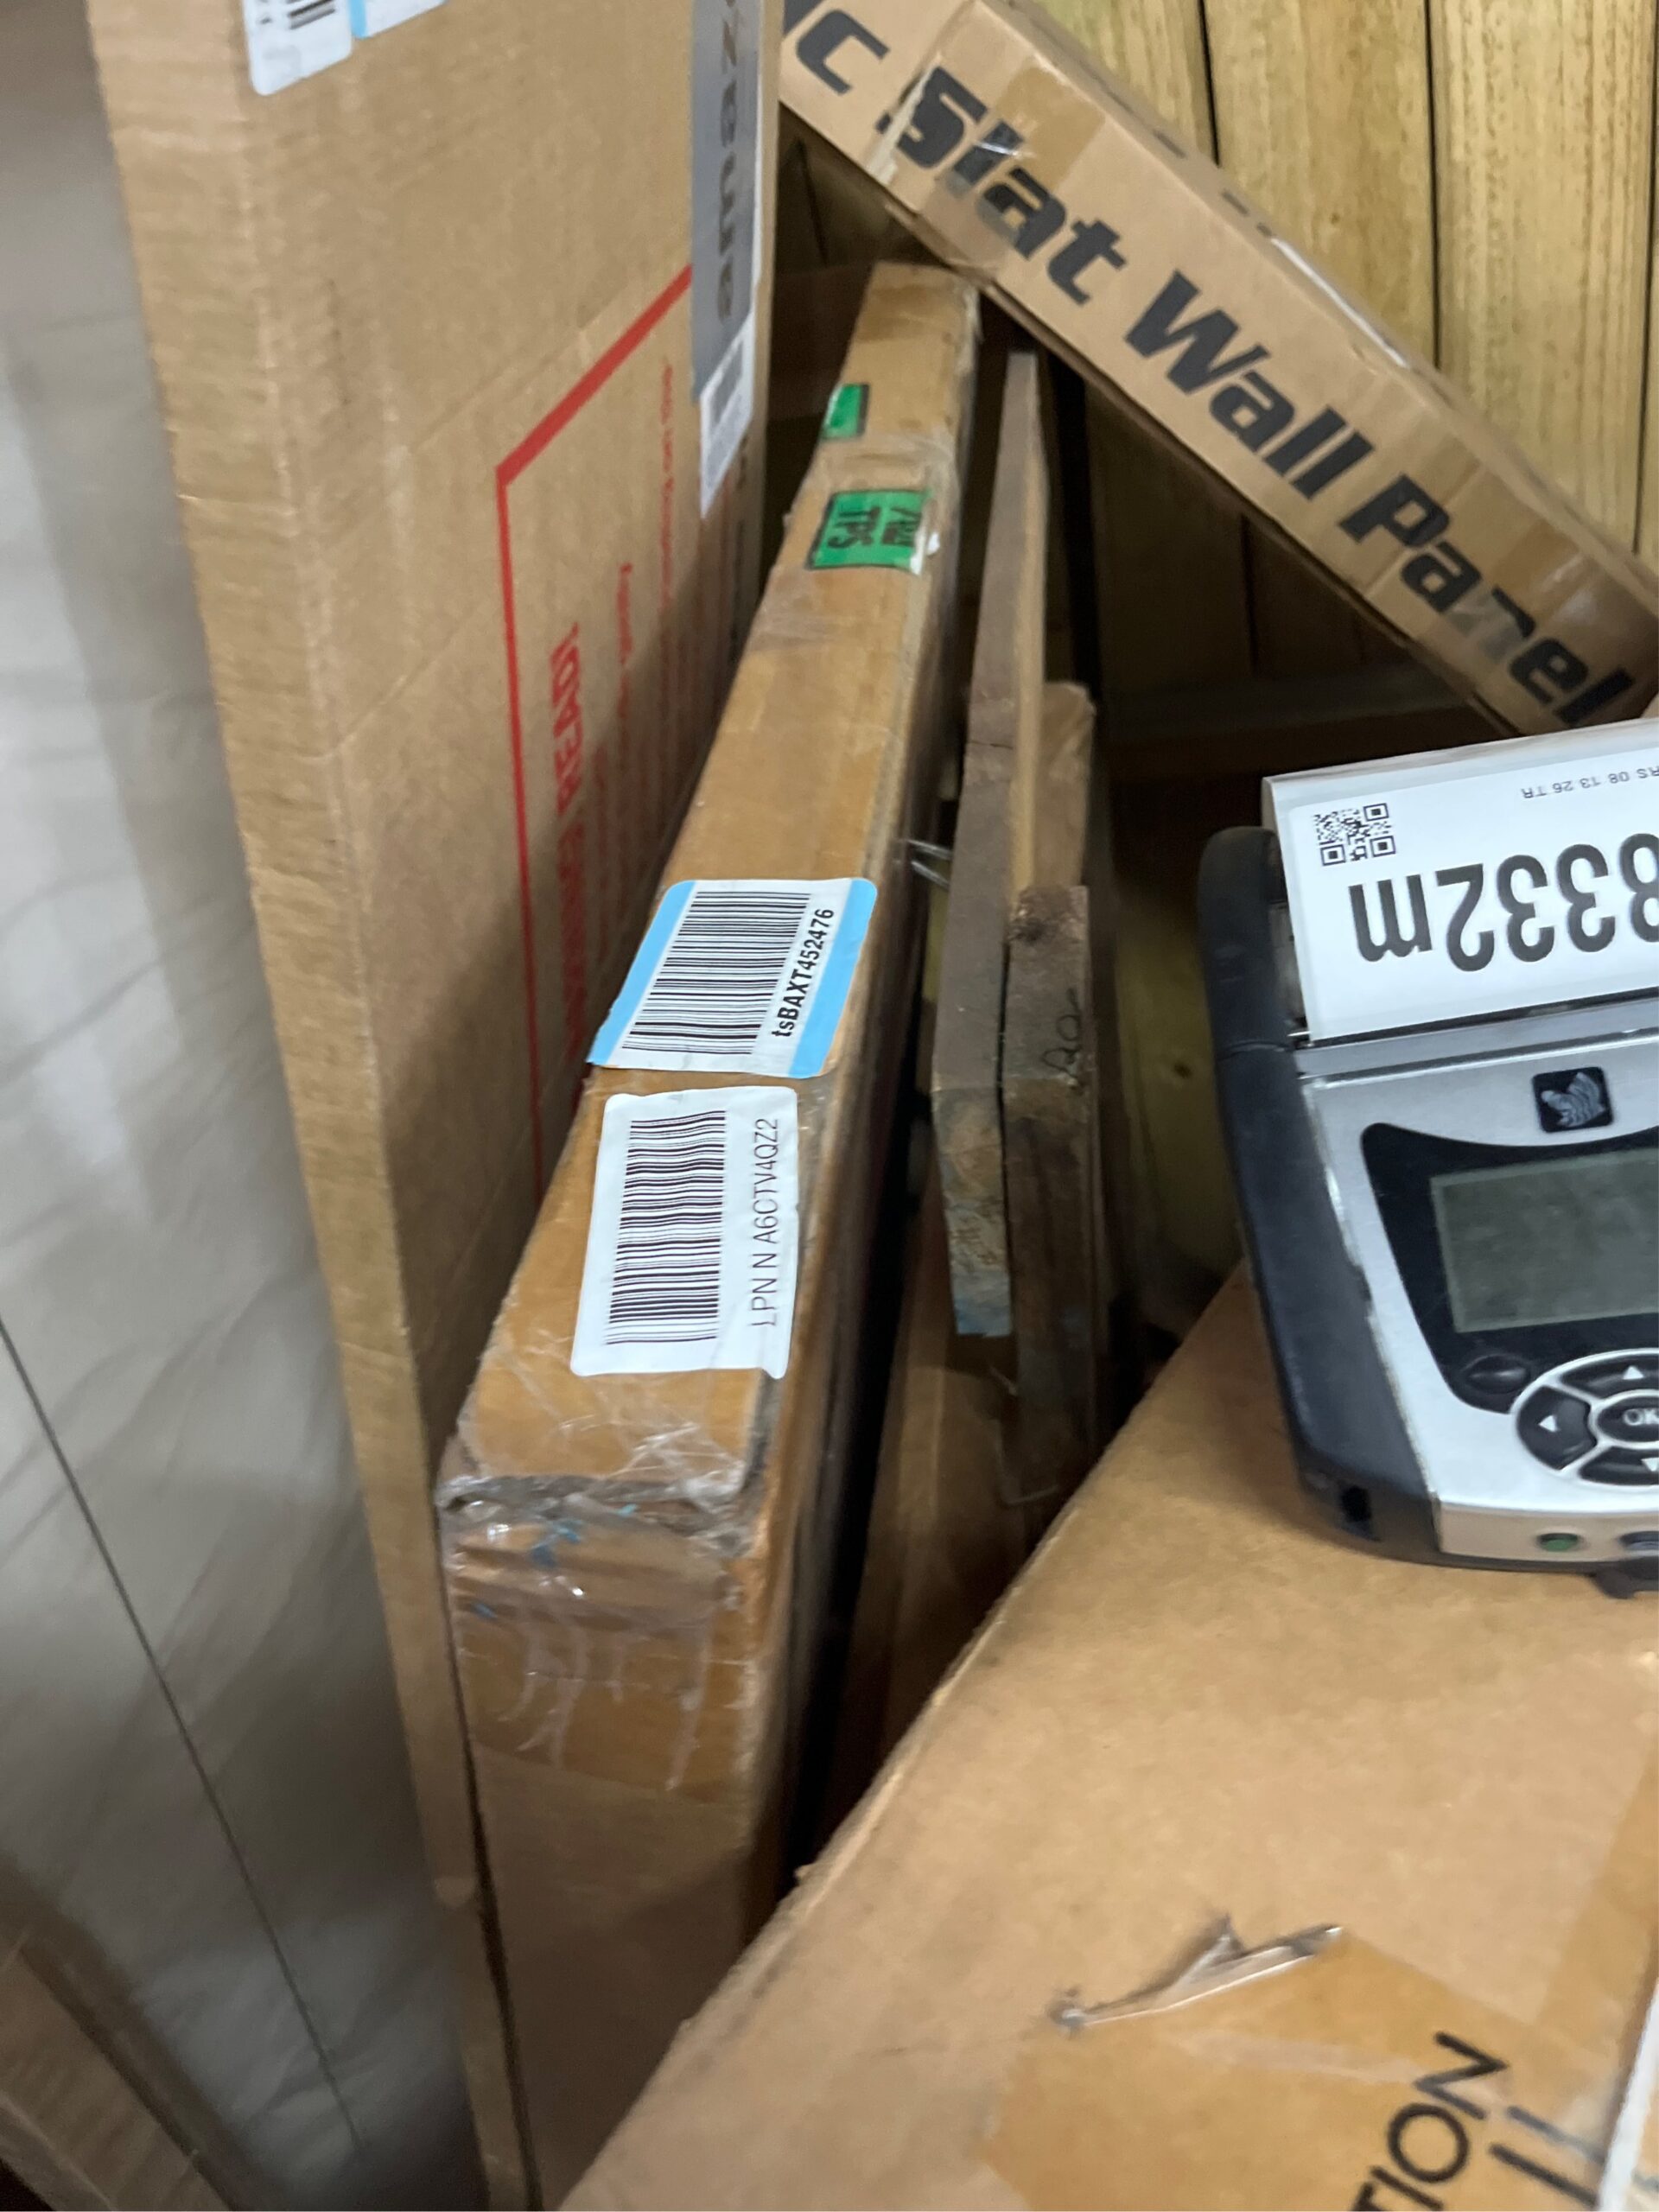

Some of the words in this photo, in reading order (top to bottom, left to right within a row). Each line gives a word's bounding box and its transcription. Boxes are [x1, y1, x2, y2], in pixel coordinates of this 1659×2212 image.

[874, 64, 1127, 307] Slat
[1123, 269, 1375, 500] Wall
[1579, 776, 1601, 789] 13
[1607, 771, 1630, 785] 08
[1521, 785, 1548, 799] TR
[1552, 780, 1574, 793] 26
[771, 908, 835, 1038] tsBAXT452476
[752, 1118, 779, 1243] A6CTV4QZ2
